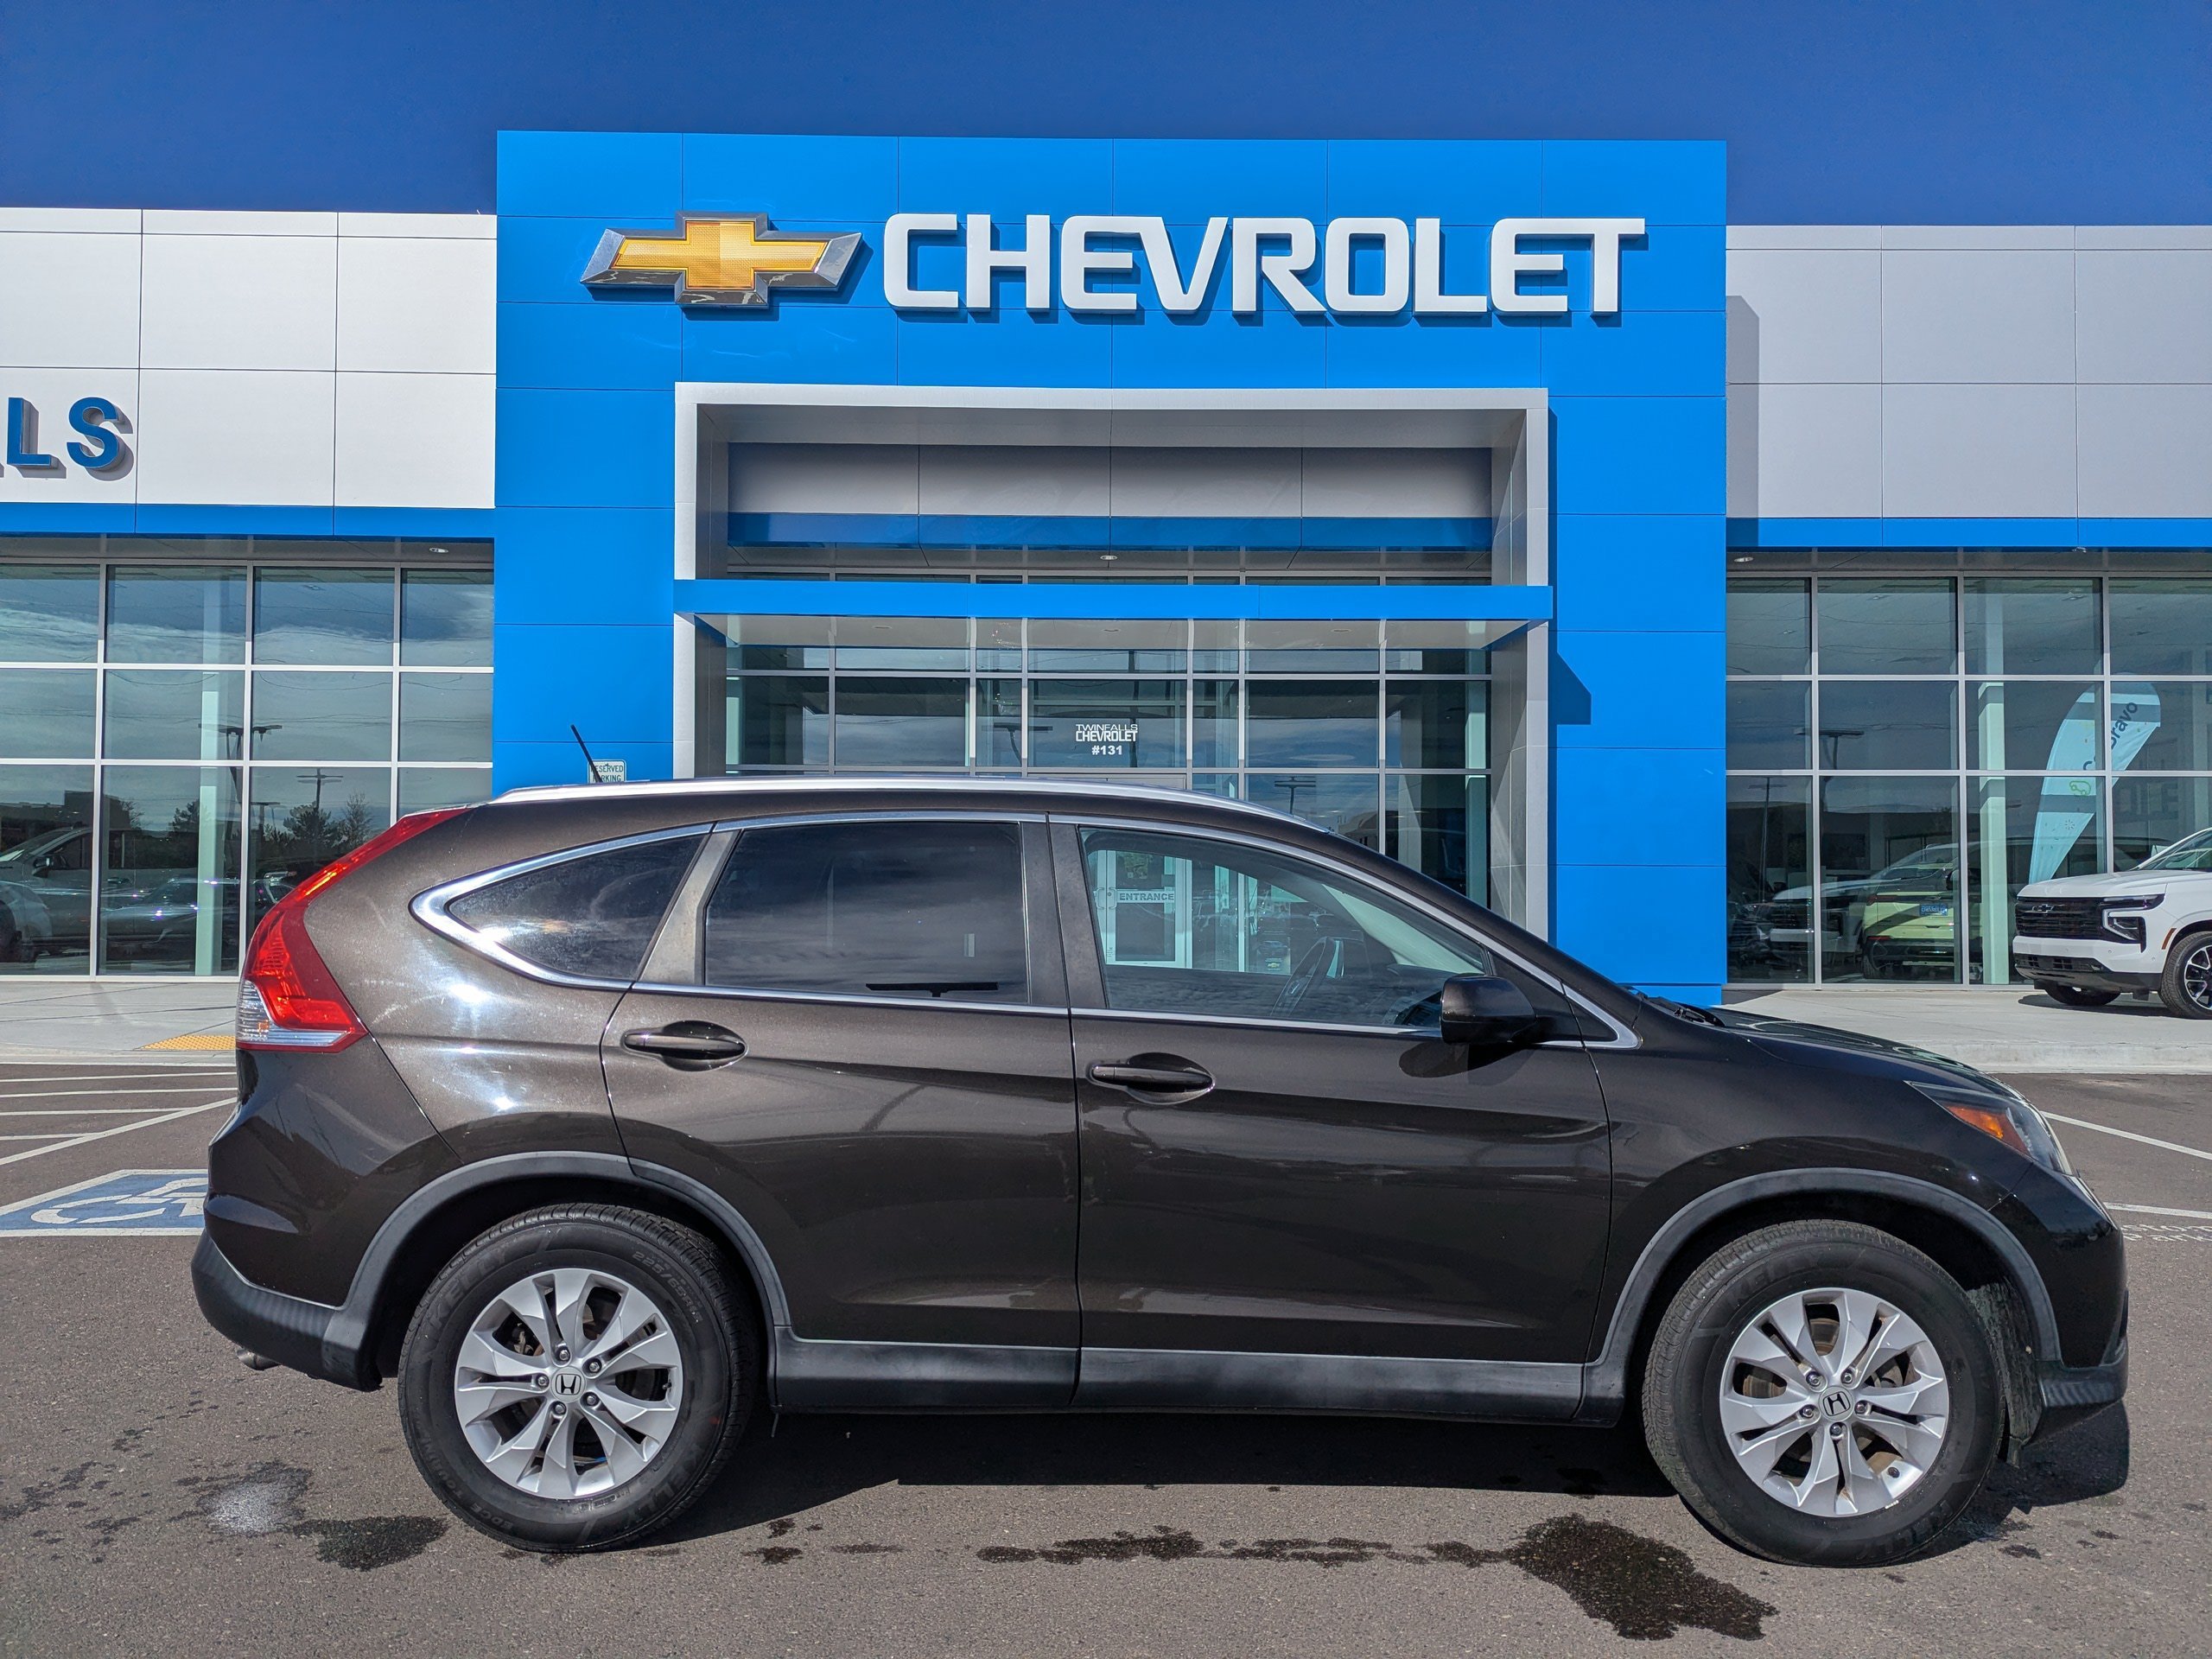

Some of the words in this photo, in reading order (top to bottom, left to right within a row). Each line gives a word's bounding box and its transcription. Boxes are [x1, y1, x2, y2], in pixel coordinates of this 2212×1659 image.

[883, 213, 1647, 316] CHEVROLET
[1075, 730, 1138, 742] CHEVROLET
[1091, 745, 1122, 755] #131
